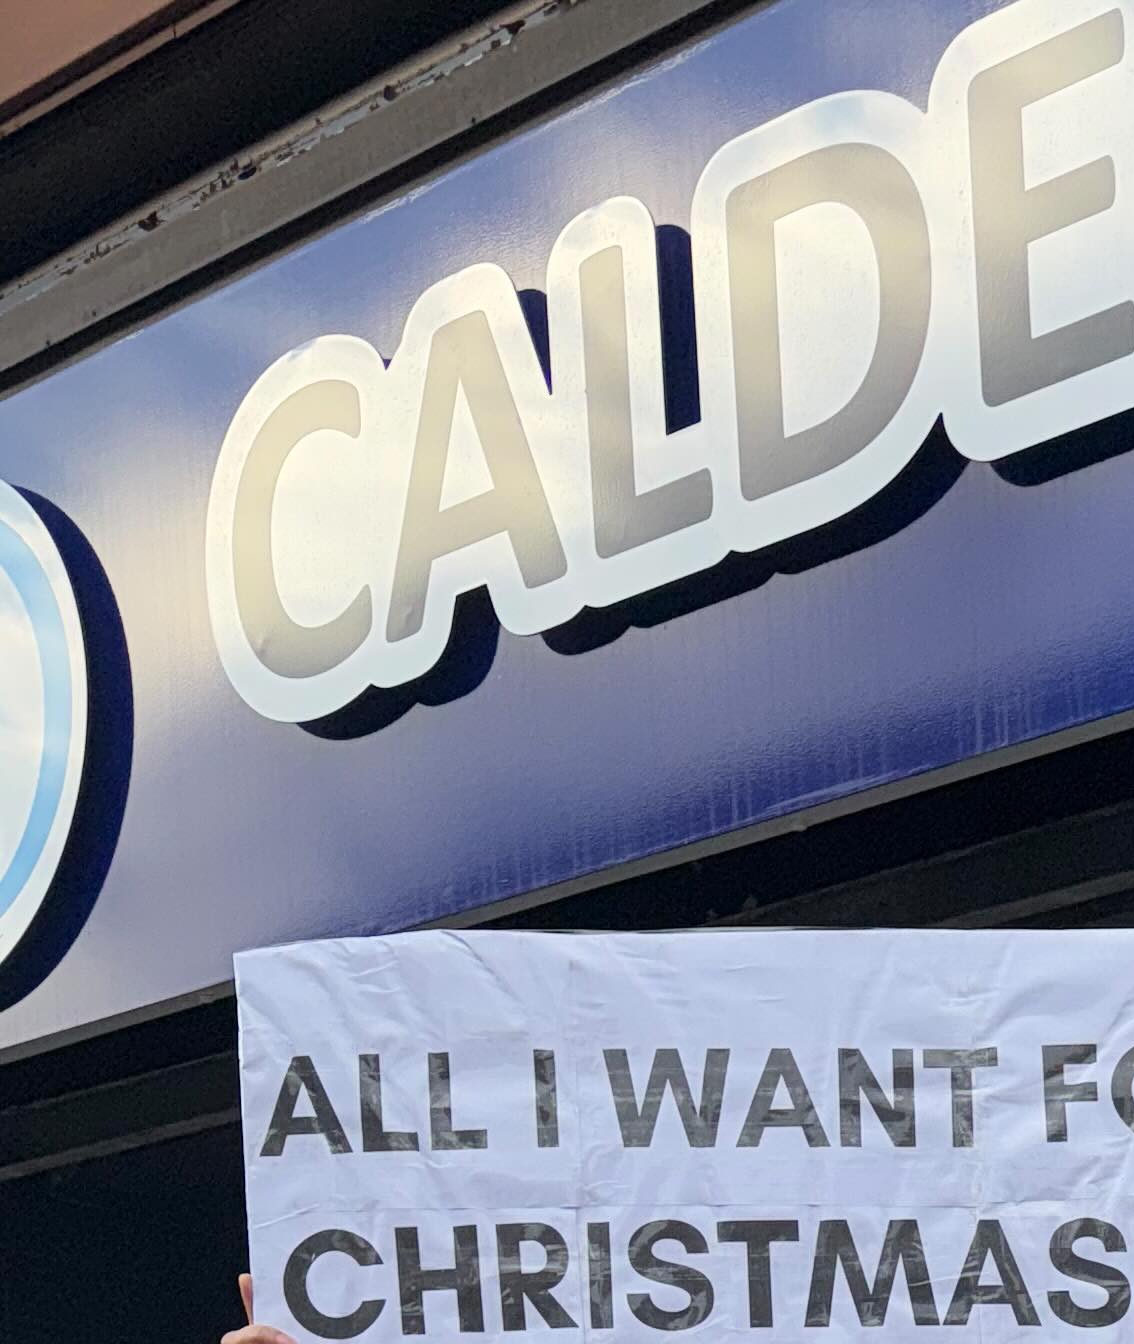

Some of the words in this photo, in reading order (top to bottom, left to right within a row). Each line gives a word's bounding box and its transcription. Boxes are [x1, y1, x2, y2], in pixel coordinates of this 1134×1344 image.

[259, 1050, 488, 1158] ALL
[533, 1048, 560, 1149] I
[600, 1045, 998, 1151] WANT
[282, 1216, 1131, 1339] CHRISTMAS
